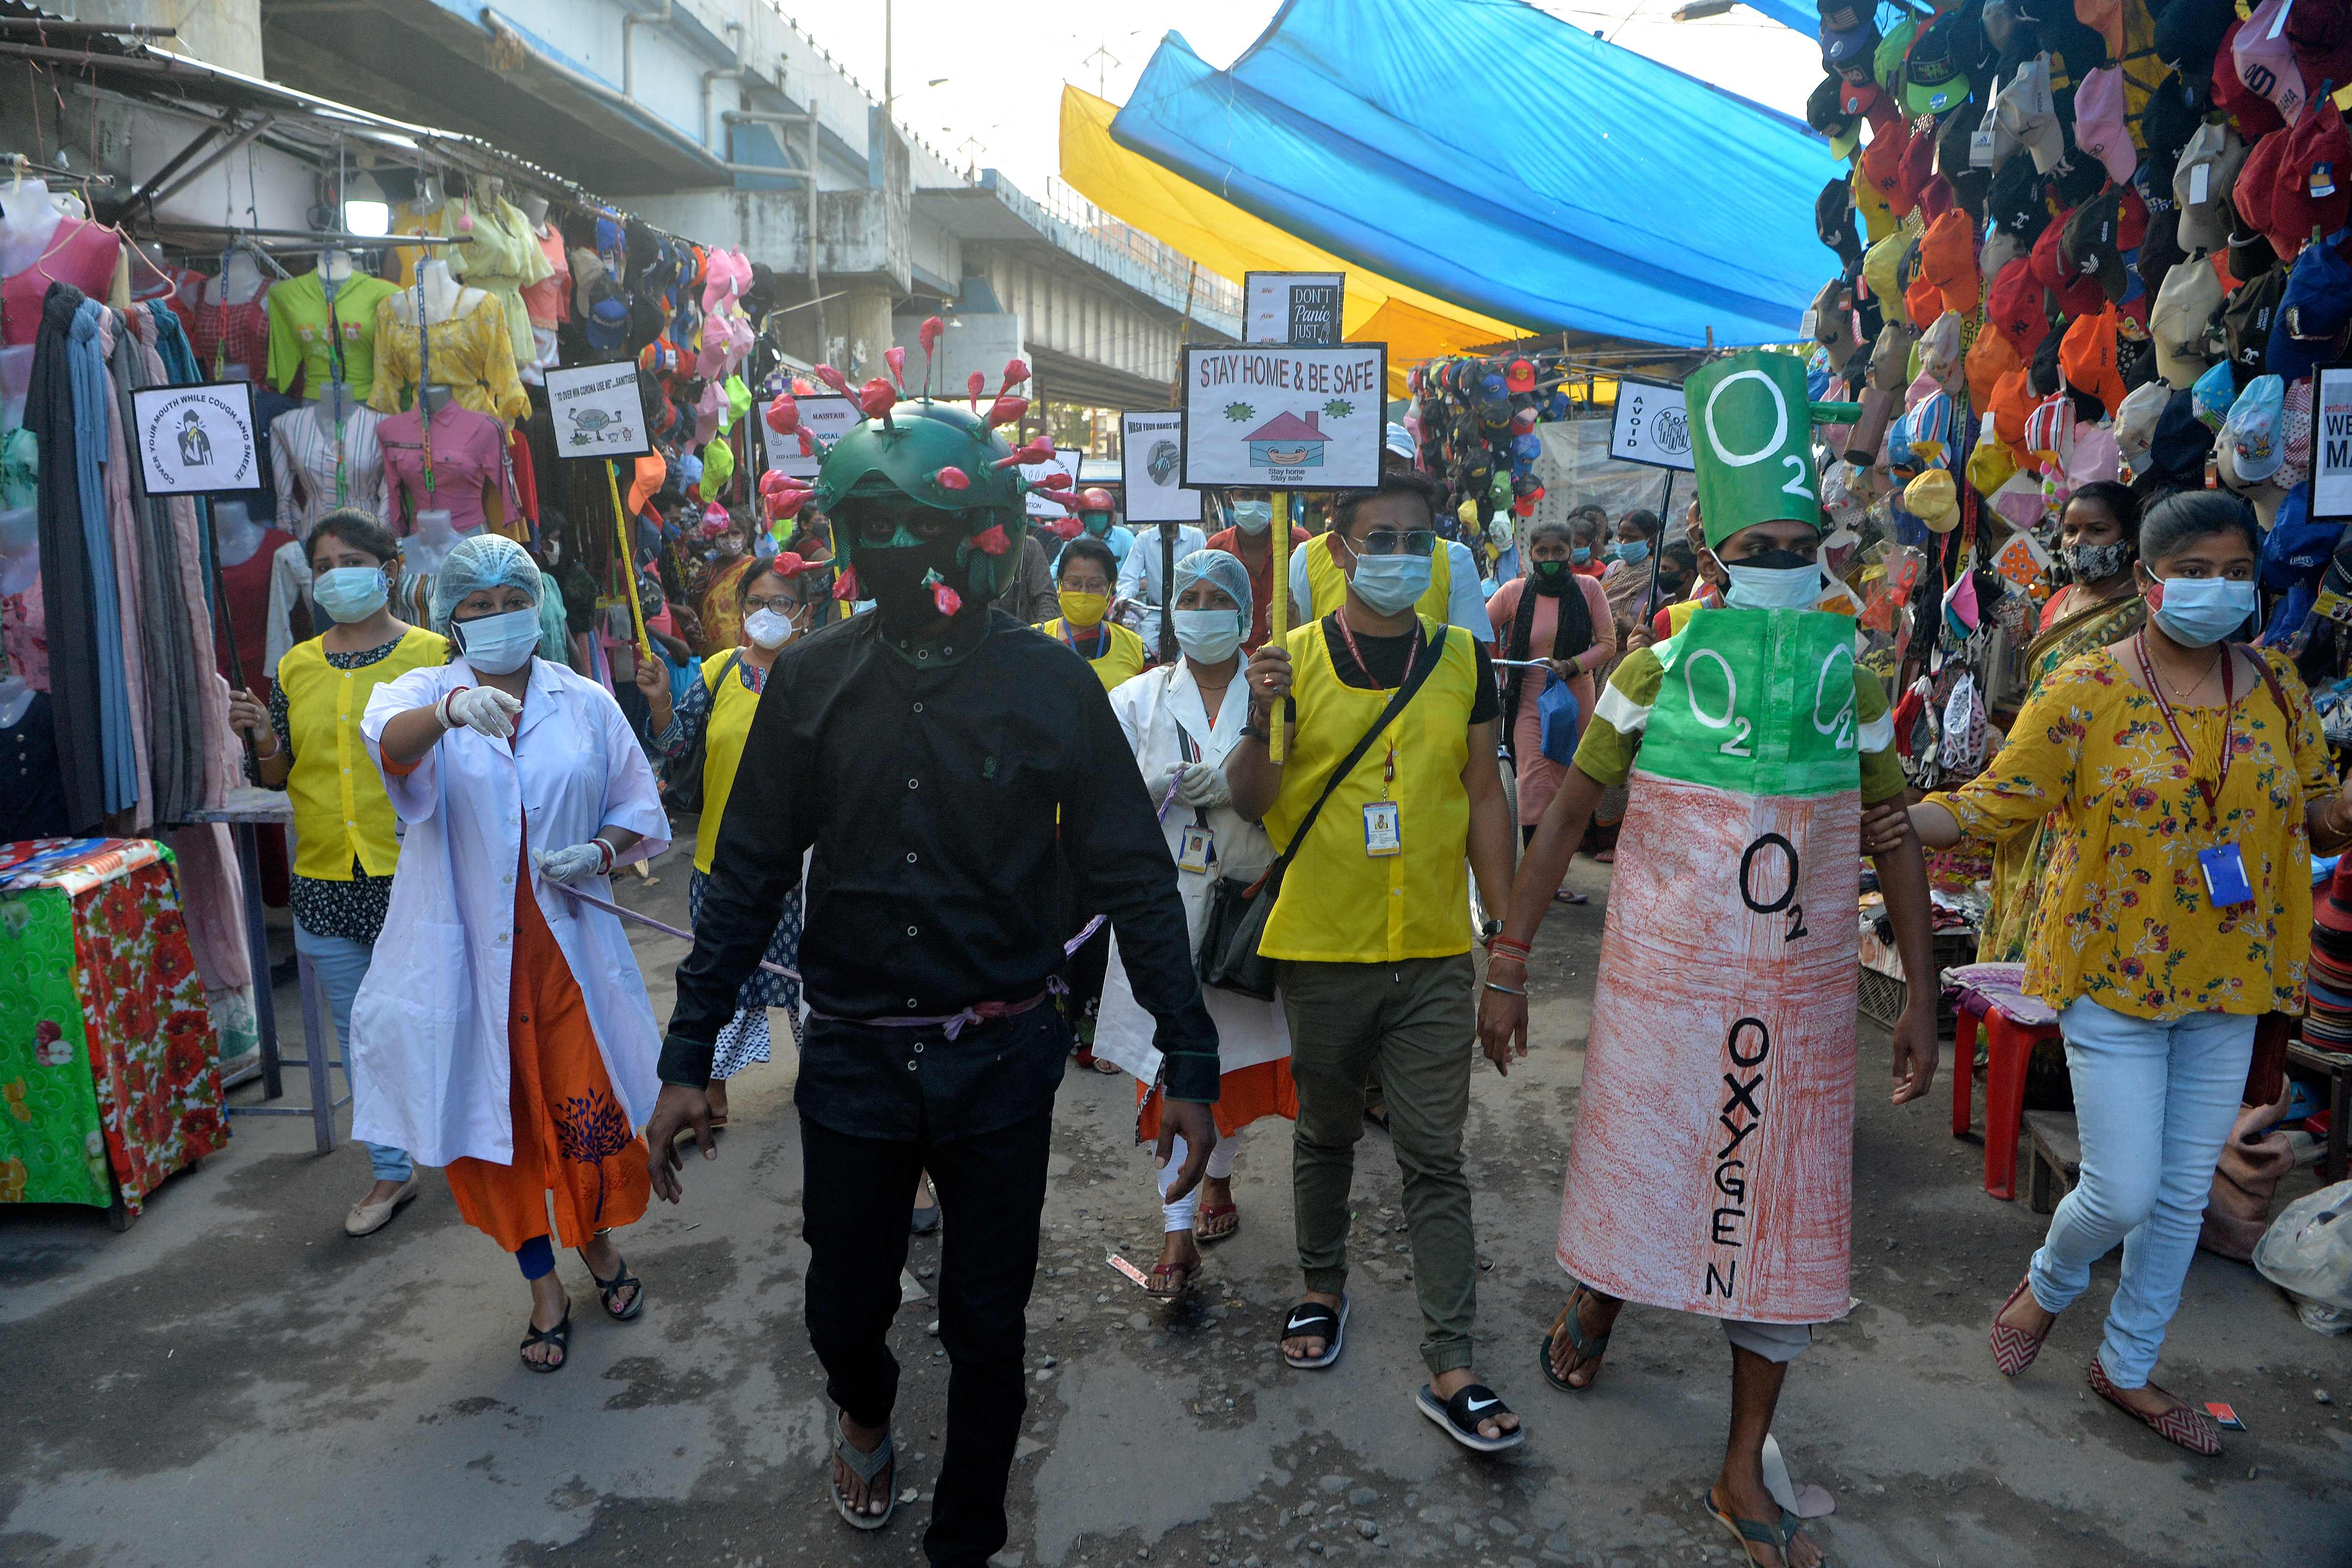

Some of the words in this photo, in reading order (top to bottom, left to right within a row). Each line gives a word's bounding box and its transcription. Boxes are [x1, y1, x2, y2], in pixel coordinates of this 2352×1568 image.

[1295, 288, 1332, 304] DON'T
[1295, 305, 1331, 322] Panic
[1295, 324, 1319, 342] JUST
[1200, 355, 1240, 388] STAY
[1243, 355, 1289, 389] HOME
[1294, 361, 1304, 391] &
[1308, 363, 1329, 394] BE
[1334, 359, 1374, 395] SAFE
[180, 395, 206, 404] WHILE
[562, 390, 572, 400] OVER
[580, 384, 596, 396] CORONA
[154, 398, 179, 424] MOUTH
[208, 397, 237, 419] COUGH
[237, 420, 249, 440] AND
[1128, 421, 1142, 434] WASH
[1143, 422, 1156, 431] YOUR
[1156, 422, 1172, 430] HANDS
[1627, 396, 1643, 447] AVOID
[149, 425, 157, 452] YOUR
[152, 455, 175, 485] COVER
[1705, 1016, 1770, 1298] OXYGEN
